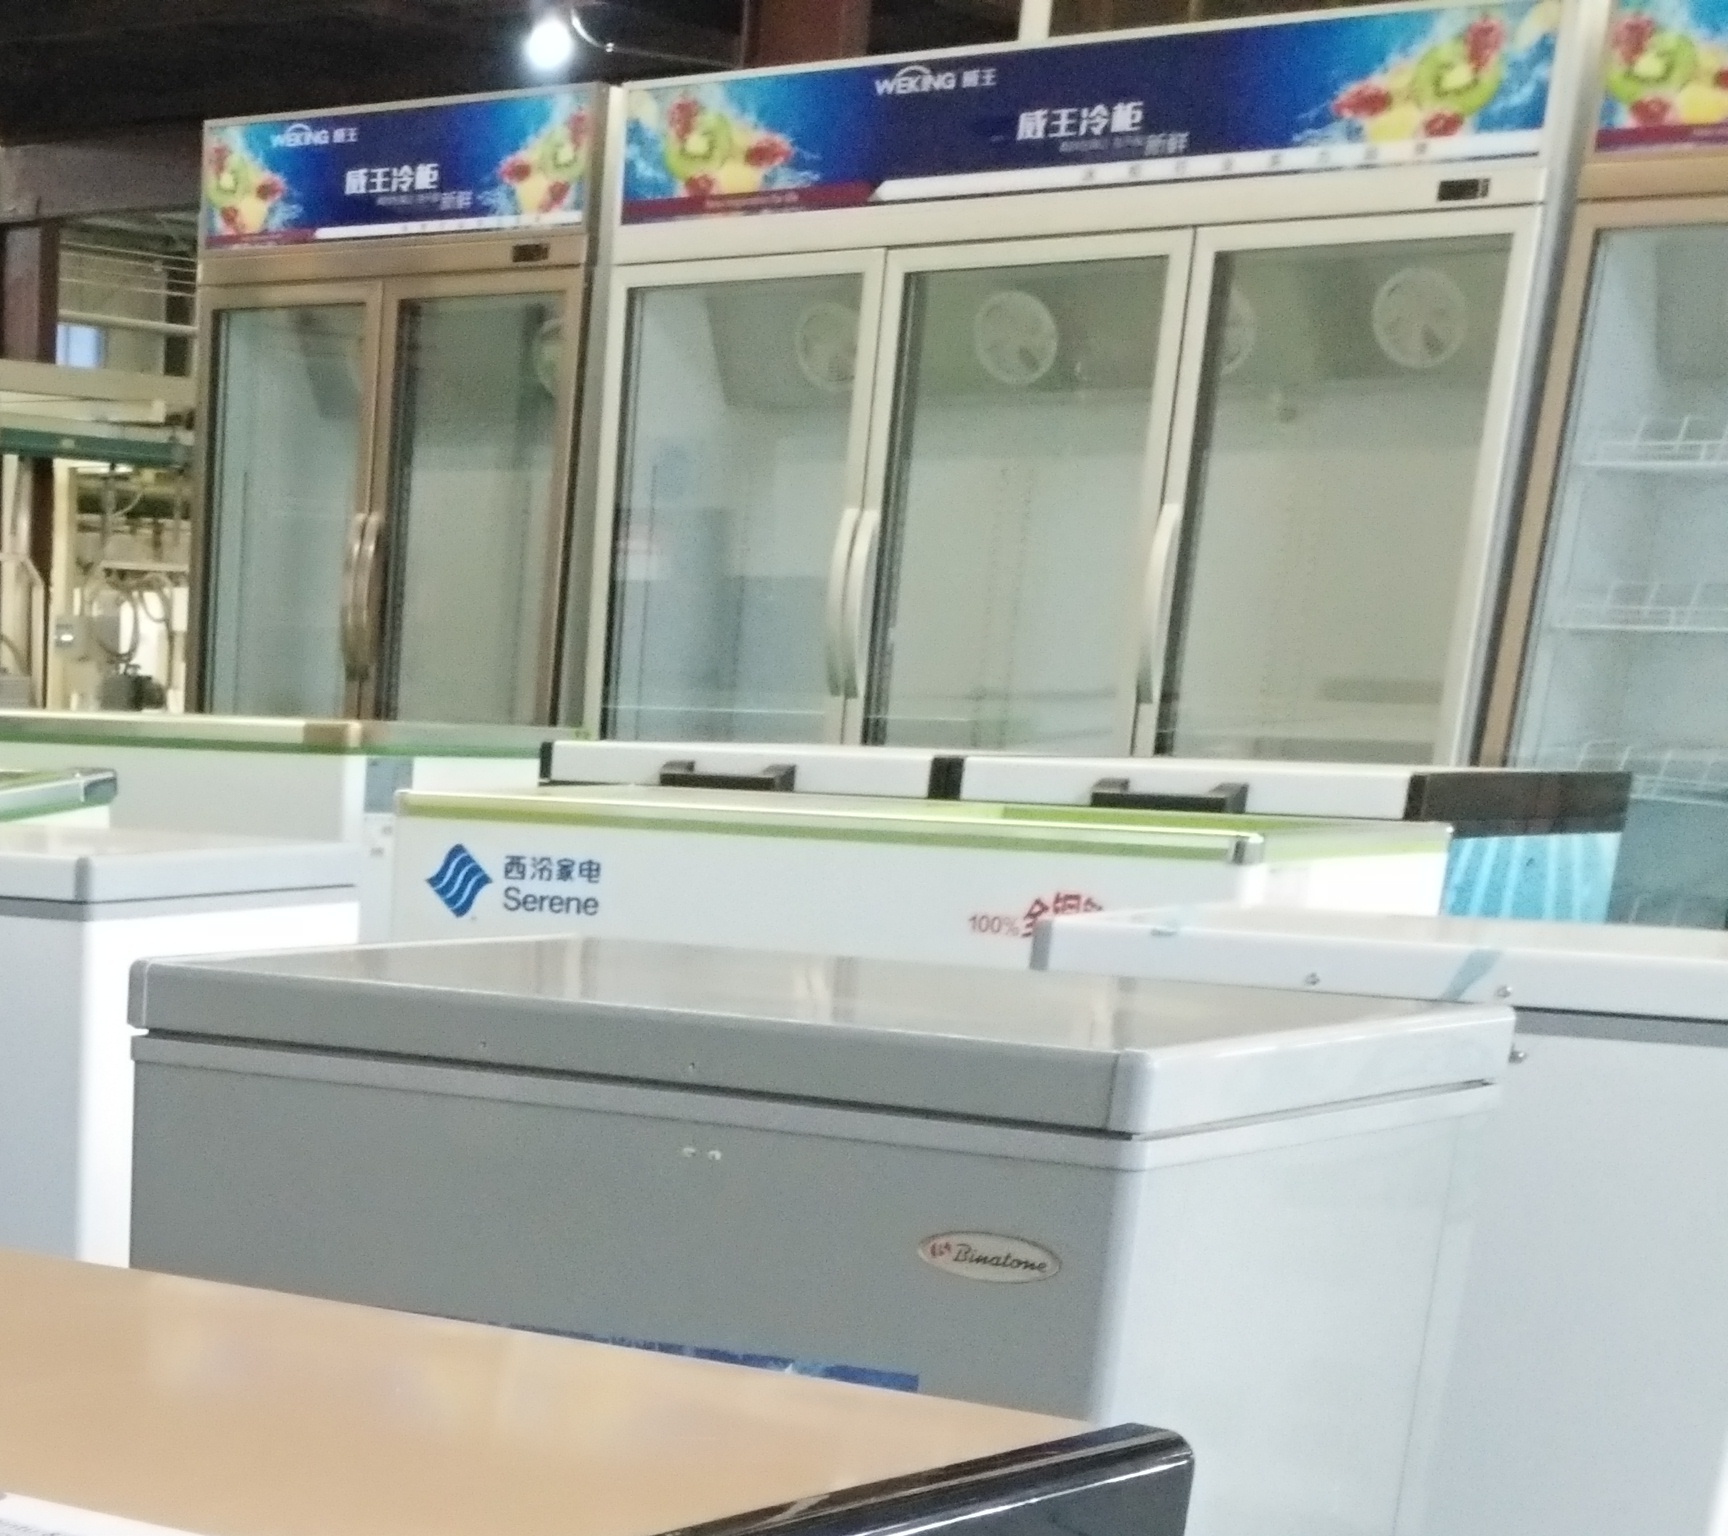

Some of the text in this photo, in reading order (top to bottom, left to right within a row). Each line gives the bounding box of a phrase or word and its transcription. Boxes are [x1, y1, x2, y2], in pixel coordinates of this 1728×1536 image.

[875, 66, 956, 95] WEKING
[1016, 100, 1143, 141] 威王冷柜
[344, 163, 439, 195] 威王冷柜
[503, 886, 599, 915] Serene
[953, 1243, 1047, 1272] Binatone
